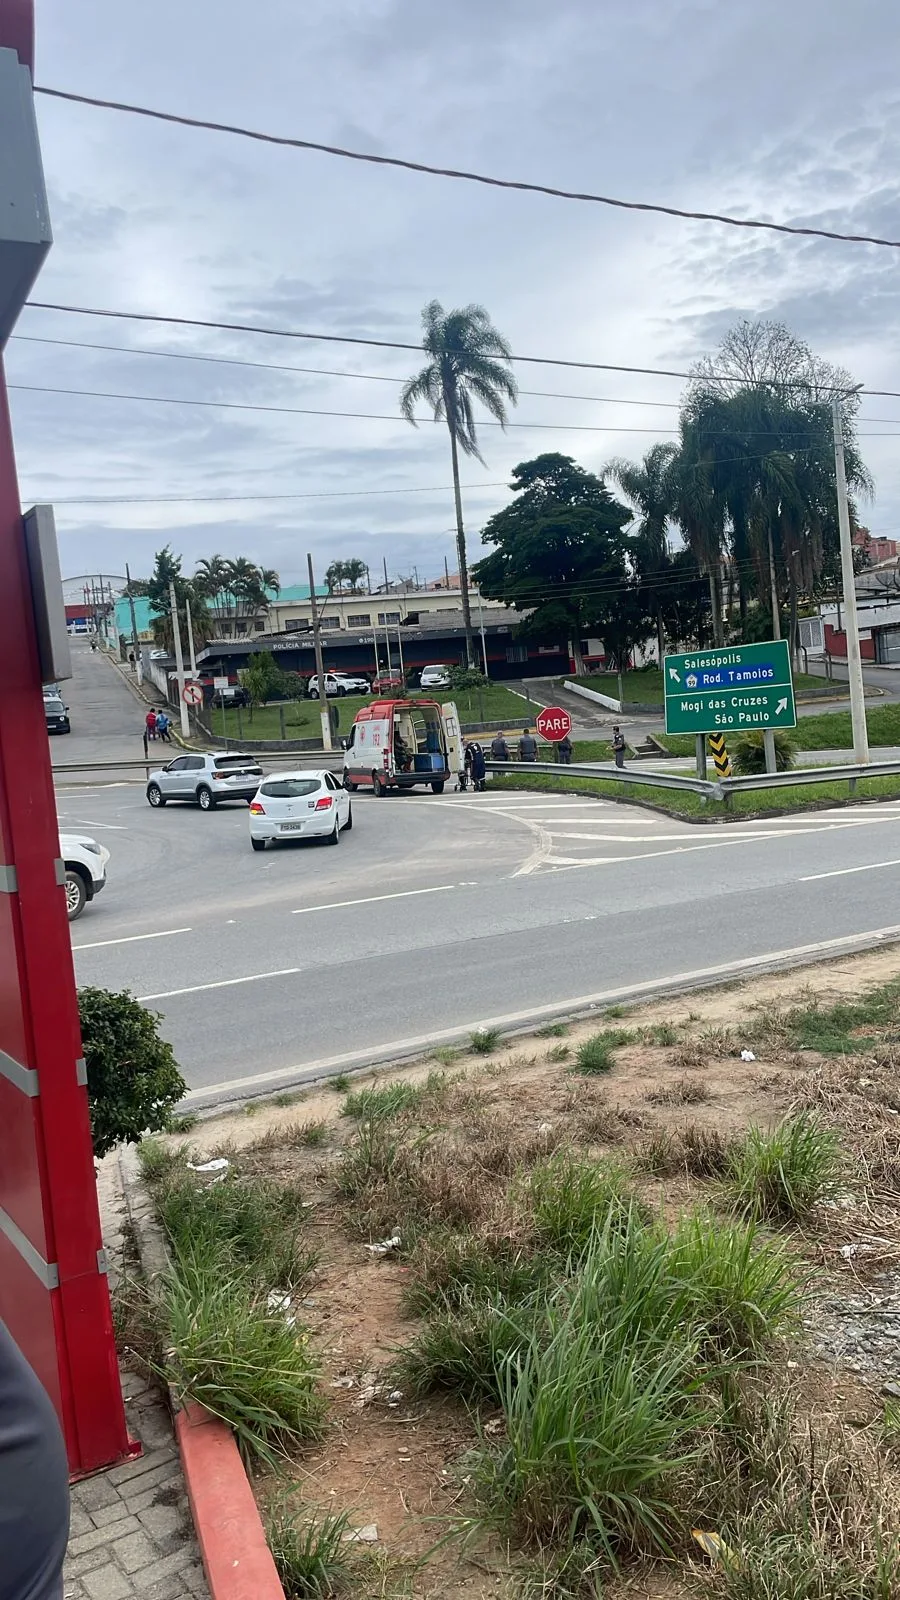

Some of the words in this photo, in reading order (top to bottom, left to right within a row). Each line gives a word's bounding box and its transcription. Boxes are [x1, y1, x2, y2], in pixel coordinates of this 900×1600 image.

[685, 654, 741, 668] Salesópolis
[703, 673, 724, 684] Rod.
[728, 668, 773, 681] Tamoios
[681, 700, 703, 712] Mogi
[708, 699, 726, 709] das
[731, 696, 768, 707] Cruzes
[539, 717, 569, 731] PARE
[715, 713, 734, 725] São
[738, 711, 769, 722] Paulo
